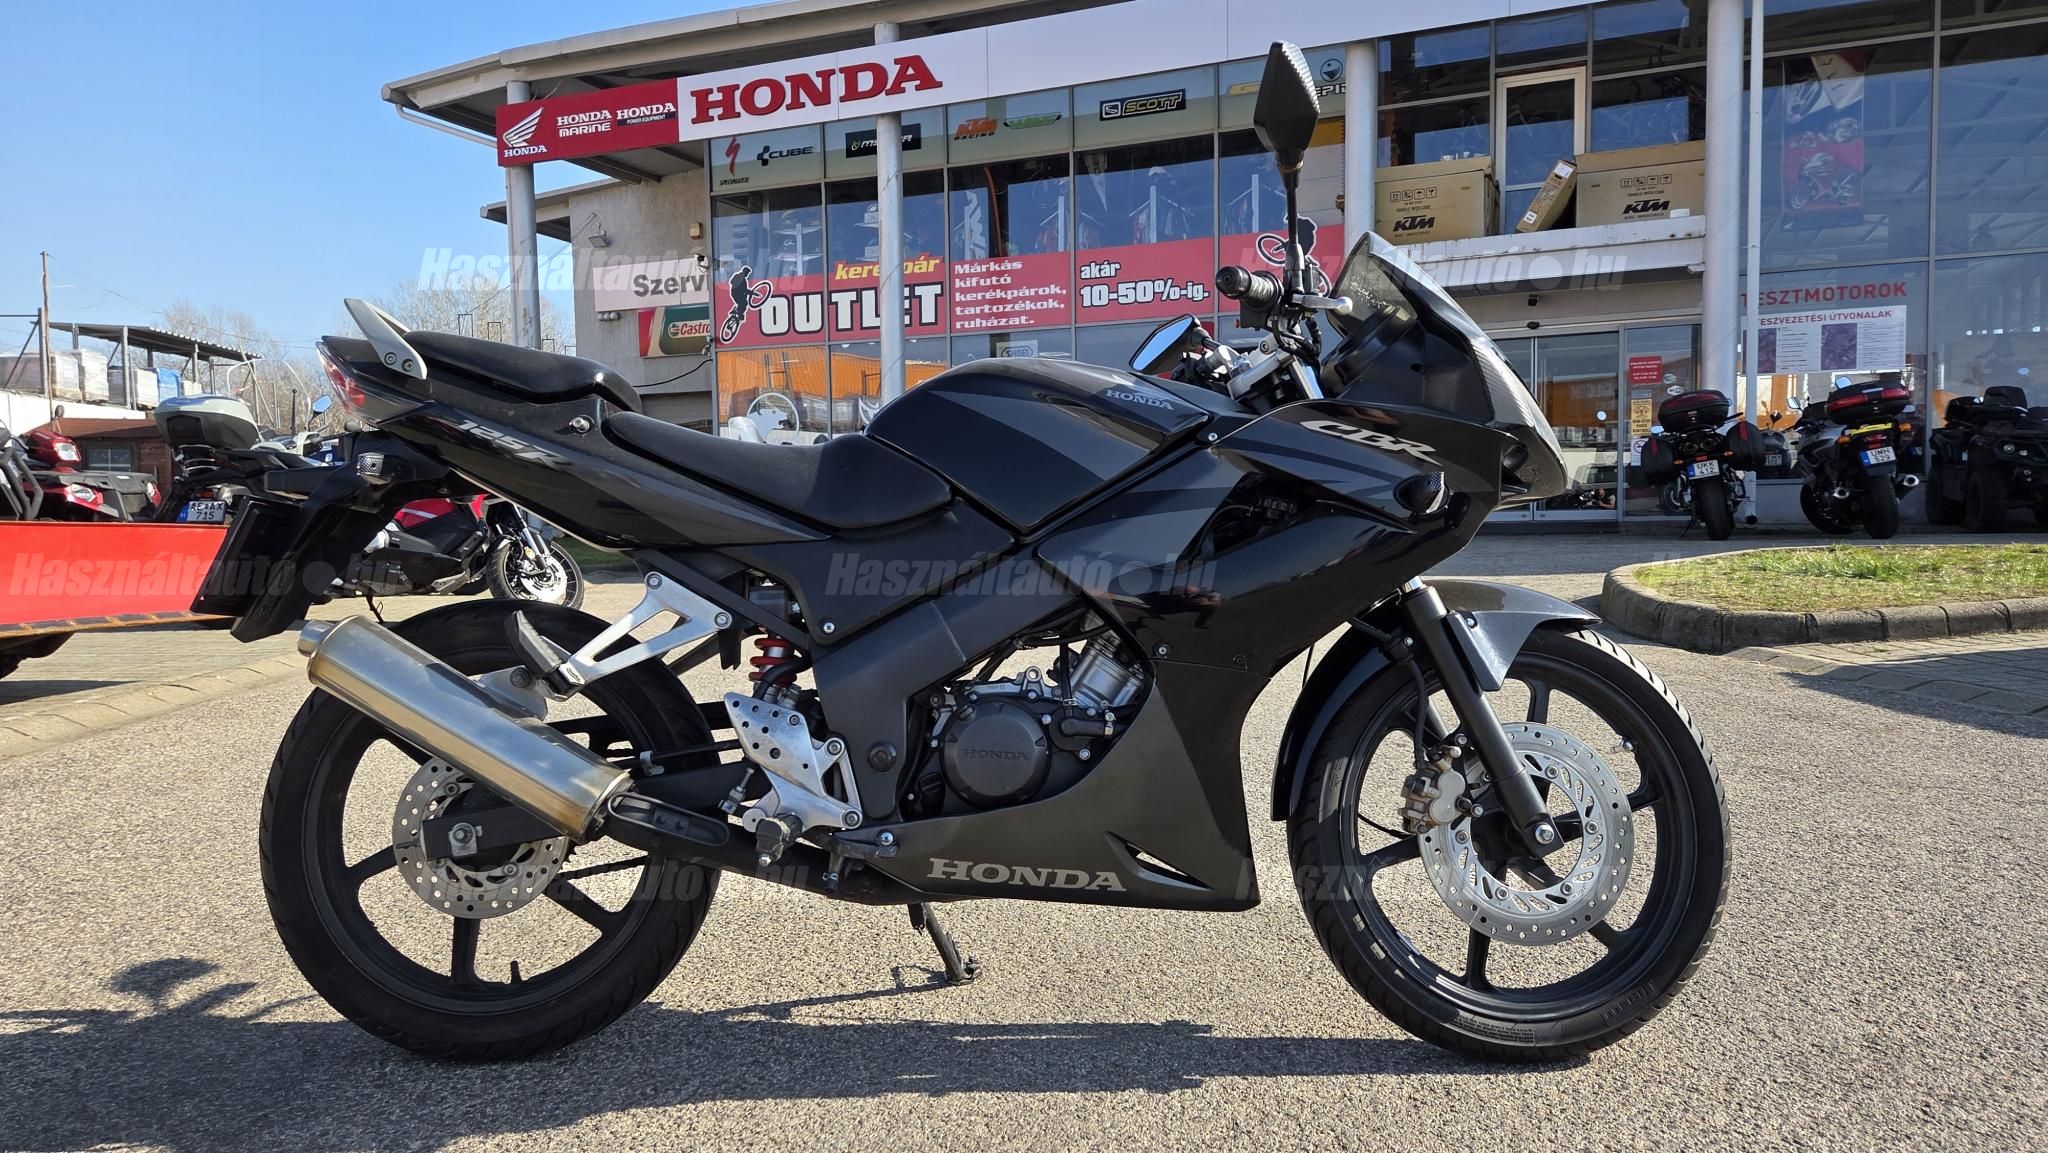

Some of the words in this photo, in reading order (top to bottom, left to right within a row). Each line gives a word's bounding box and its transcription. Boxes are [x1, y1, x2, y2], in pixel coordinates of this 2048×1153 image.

[690, 53, 944, 125] HONDA
[616, 102, 677, 120] HONDA
[1125, 93, 1182, 113] SCOTT
[556, 109, 612, 126] HONDA
[627, 117, 641, 125] POWER
[642, 114, 666, 123] EQUIPMENT
[955, 117, 997, 136] KTM
[953, 131, 996, 140] RACING
[503, 144, 548, 159] HONDA
[769, 145, 815, 160] CUBE
[1622, 198, 1671, 215] KTM
[1392, 214, 1436, 232] KTM
[954, 259, 1023, 275] Márkás
[1080, 260, 1121, 281] akár
[955, 274, 1012, 289] kifutó
[955, 284, 1067, 303] kerékpárok,
[1080, 279, 1210, 309] 10-50%-ig.
[955, 298, 1065, 316] tartozékok,
[955, 315, 1035, 329] ruházat.
[1758, 314, 1827, 326] ESZVEZETÉSI
[1829, 309, 1893, 321] ÚTVONALAK
[1105, 388, 1175, 412] HONDA
[1299, 419, 1443, 467] CBR
[196, 511, 215, 520] 715
[961, 748, 1031, 762] HONDA
[926, 856, 1128, 892] HONDA
